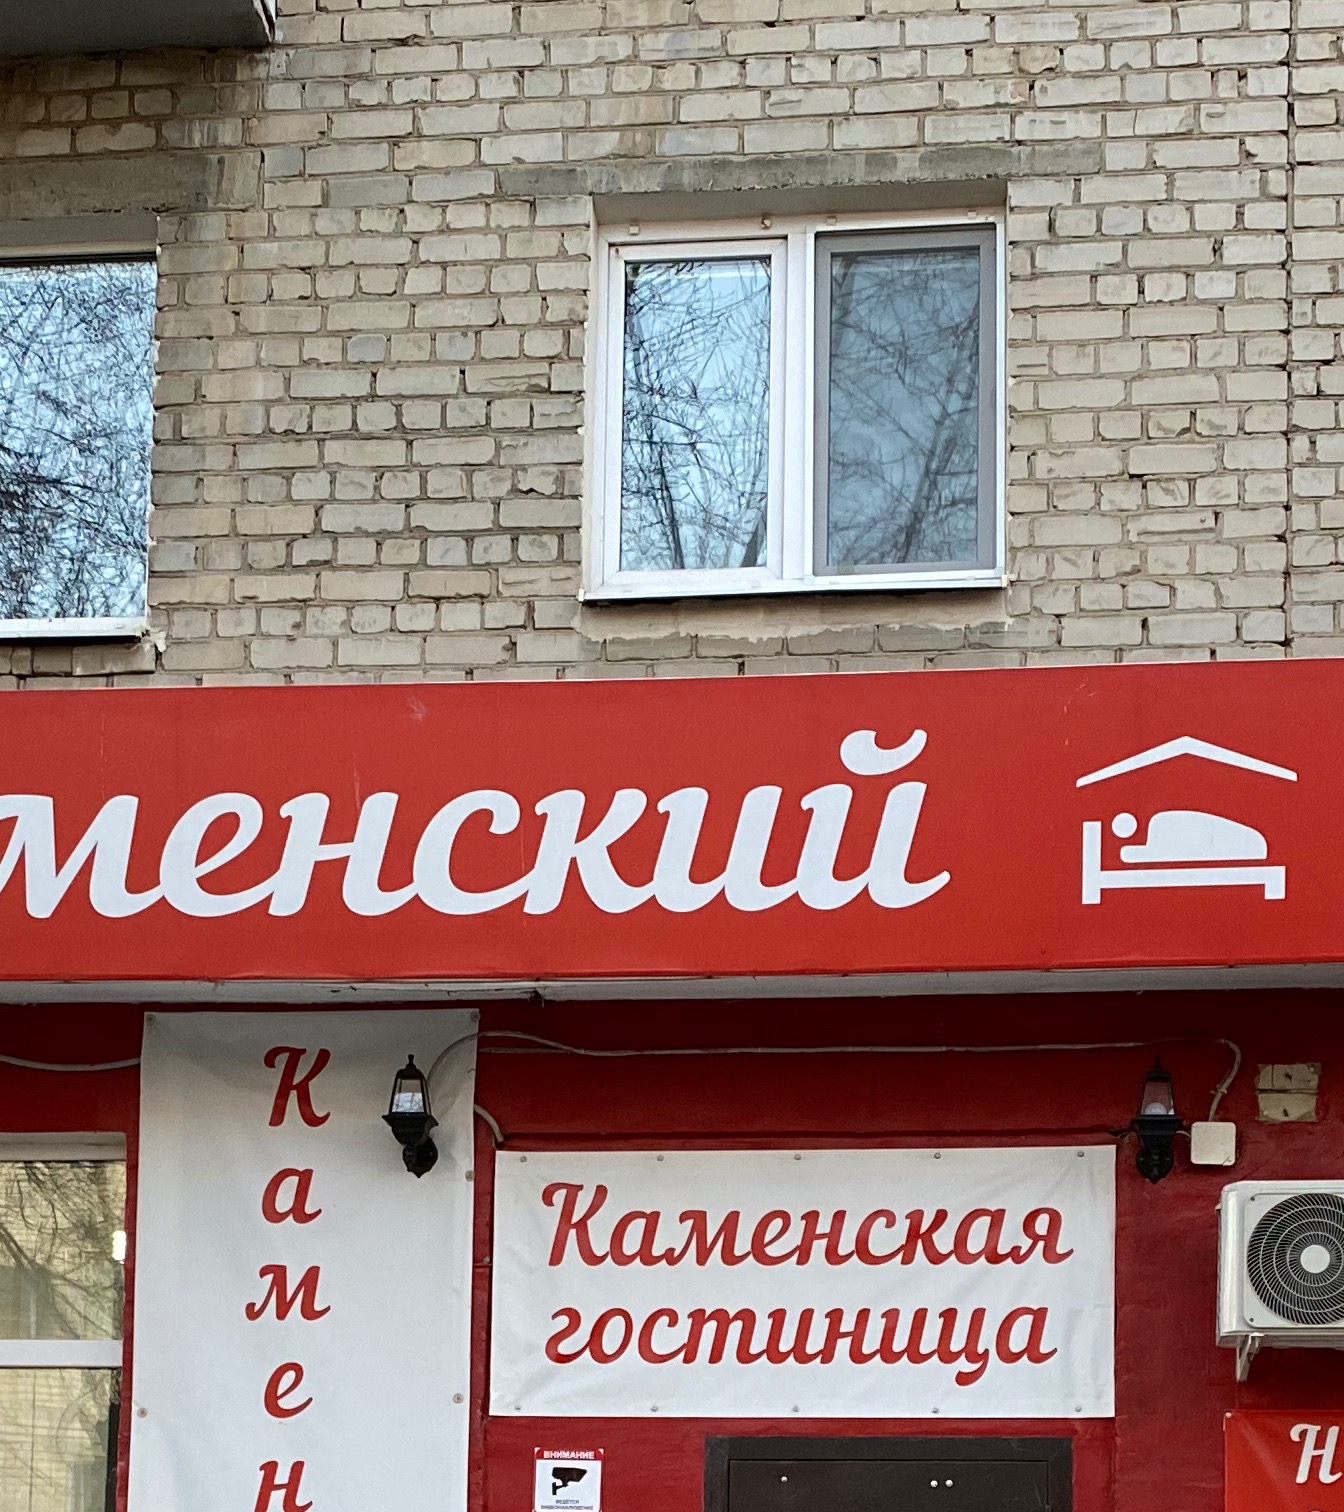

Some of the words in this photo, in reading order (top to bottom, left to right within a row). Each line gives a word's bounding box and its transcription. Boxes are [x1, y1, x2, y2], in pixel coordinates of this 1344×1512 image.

[542, 1182, 1074, 1267] Каменская
[545, 1307, 1058, 1386] гостиница
[543, 1450, 595, 1460] ВНИМАНИЕ
